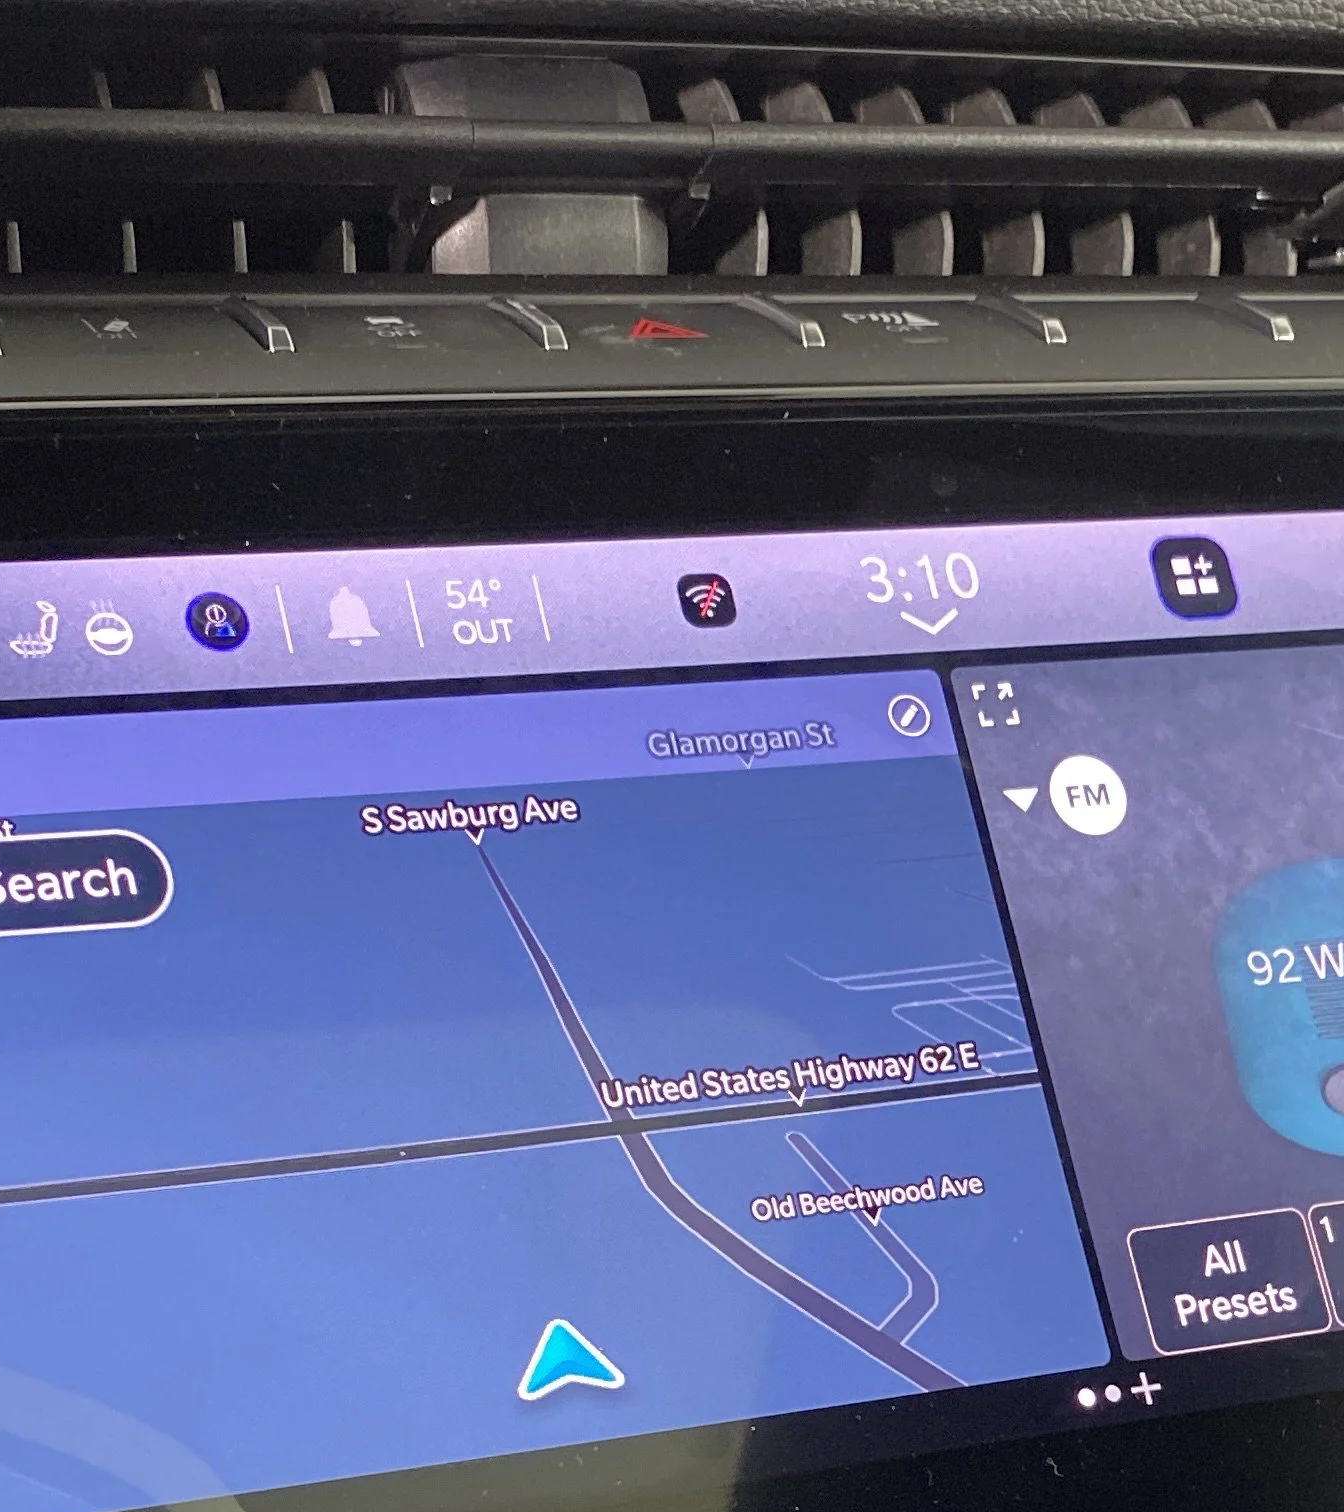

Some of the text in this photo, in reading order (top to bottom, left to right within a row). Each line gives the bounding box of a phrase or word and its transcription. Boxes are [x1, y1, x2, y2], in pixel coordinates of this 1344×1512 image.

[859, 552, 980, 603] 3:10
[452, 617, 513, 646] OUT
[647, 722, 835, 760] Glamorgan St
[1064, 782, 1111, 809] FM
[361, 796, 580, 835] S Sawburg Ave
[1247, 947, 1302, 986] 92
[598, 1043, 981, 1109] United States Highway 62 E
[751, 1175, 985, 1222] Old Beechwood Ave
[1320, 1216, 1335, 1243] 1
[1204, 1239, 1247, 1277] All
[1174, 1282, 1299, 1328] Presets
